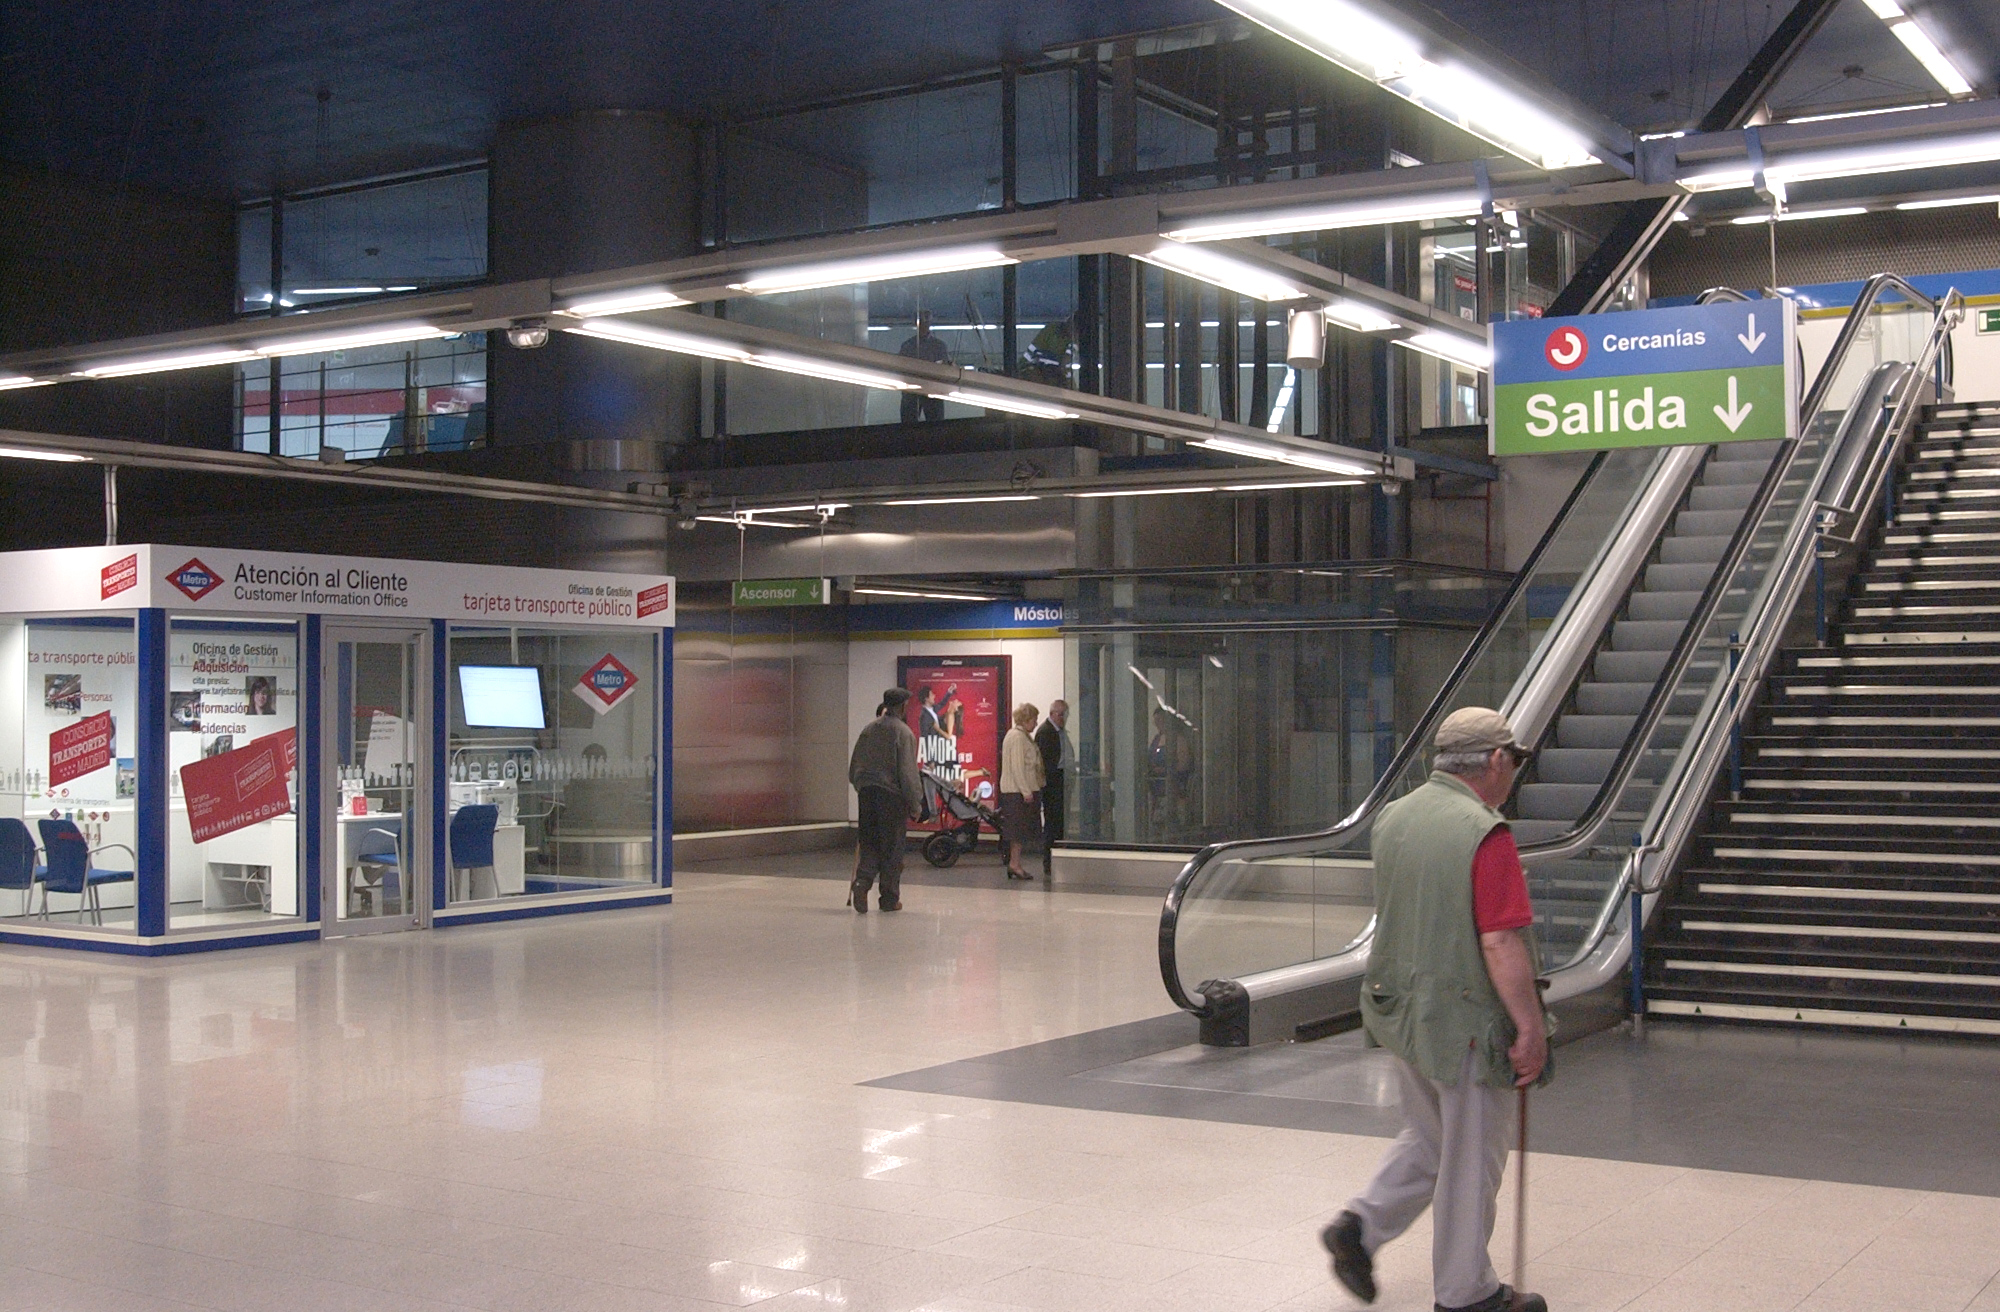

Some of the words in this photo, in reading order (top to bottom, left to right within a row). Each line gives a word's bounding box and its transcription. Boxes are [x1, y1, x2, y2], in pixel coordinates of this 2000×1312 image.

[1602, 328, 1706, 353] Cercanías
[1525, 387, 1687, 438] Salida
[181, 574, 209, 587] Metro
[234, 562, 319, 587] Atención
[325, 569, 341, 588] al
[346, 568, 408, 591] Cliente
[234, 585, 297, 603] Customer
[300, 588, 370, 606] Information
[373, 592, 408, 608] Office
[568, 583, 594, 595] Oficina
[595, 585, 605, 596] de
[606, 585, 633, 598] Gestión
[739, 586, 798, 600] Ascensor
[463, 592, 510, 615] tarjeta
[515, 595, 585, 617] transporte
[588, 598, 632, 618] público
[43, 652, 104, 667] transporte
[192, 642, 226, 655] Oficina
[229, 644, 240, 655] de
[243, 643, 279, 656] Gestión
[597, 673, 623, 686] Metro
[192, 701, 250, 714] Información
[62, 715, 108, 745] CONSORCIO
[52, 733, 108, 766] TRANSPORTES
[917, 733, 957, 765] AMOR
[76, 750, 108, 774] MADRID
